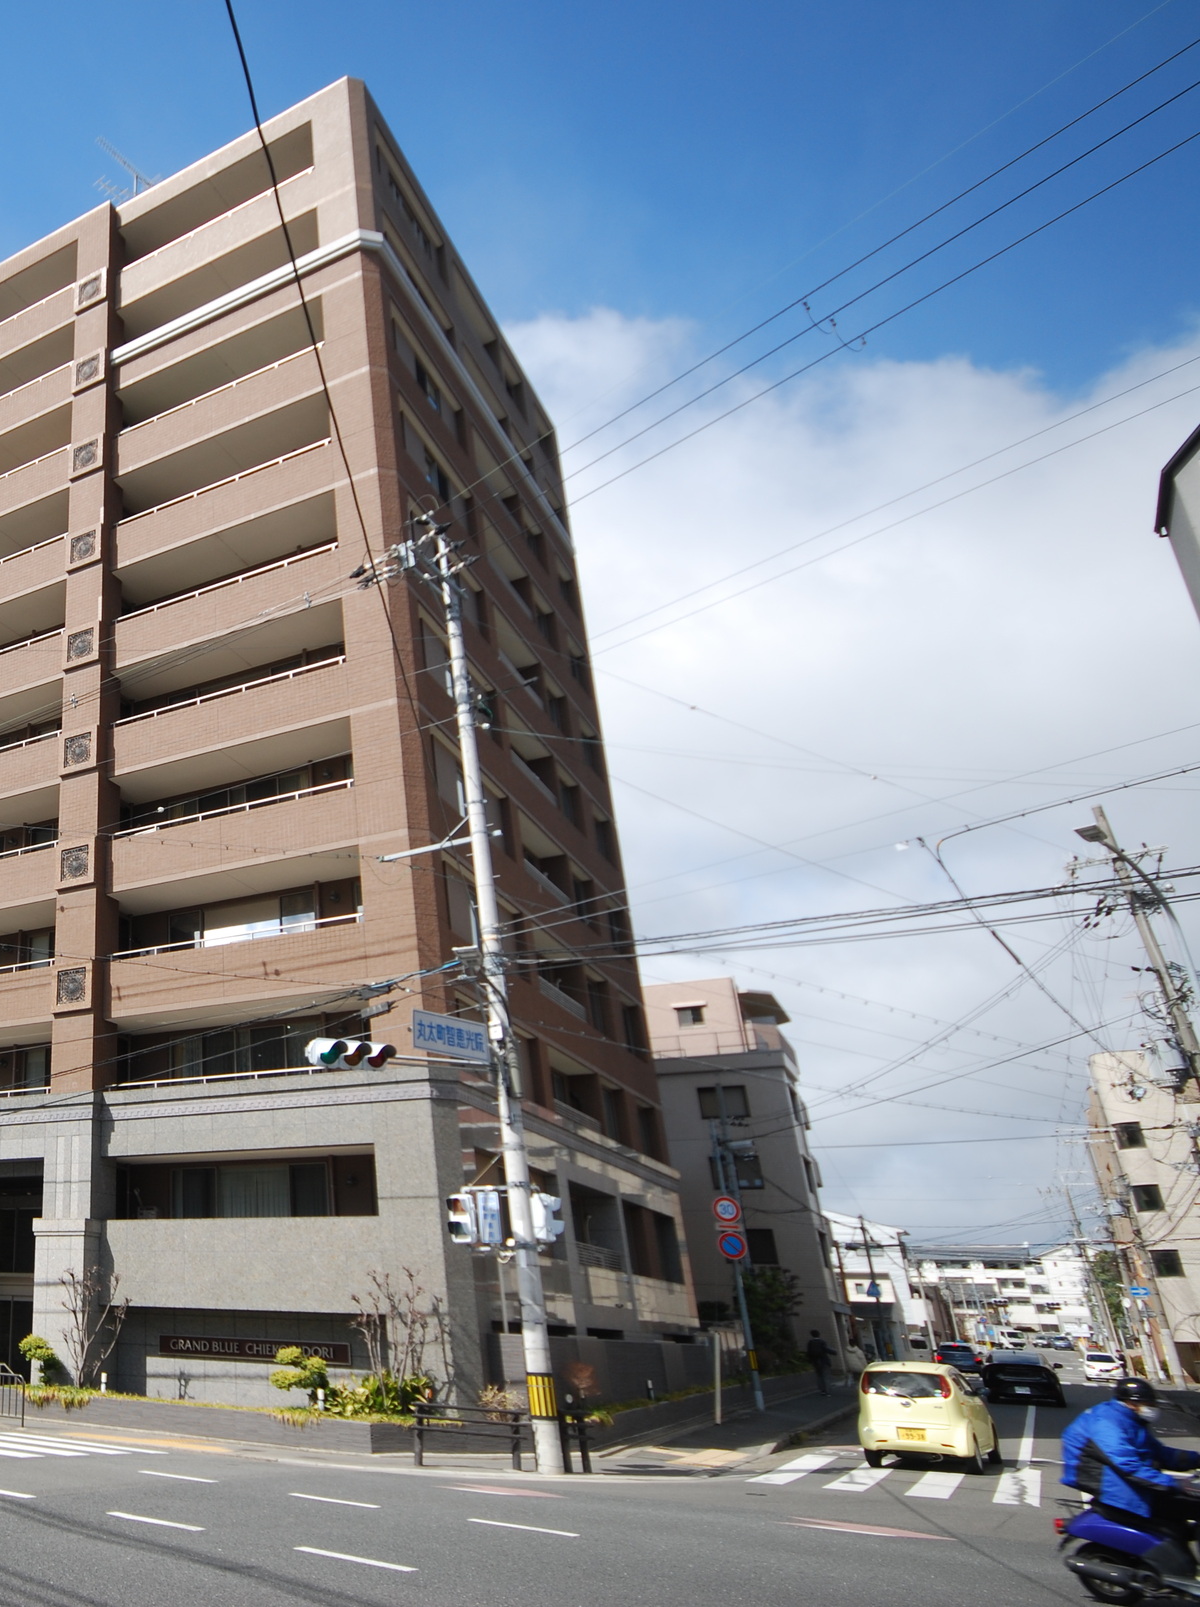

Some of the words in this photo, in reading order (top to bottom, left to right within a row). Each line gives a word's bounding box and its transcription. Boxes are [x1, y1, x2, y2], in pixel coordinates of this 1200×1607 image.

[719, 1203, 735, 1216] 30
[169, 1338, 210, 1352] GRAND
[212, 1340, 240, 1354] BLUE
